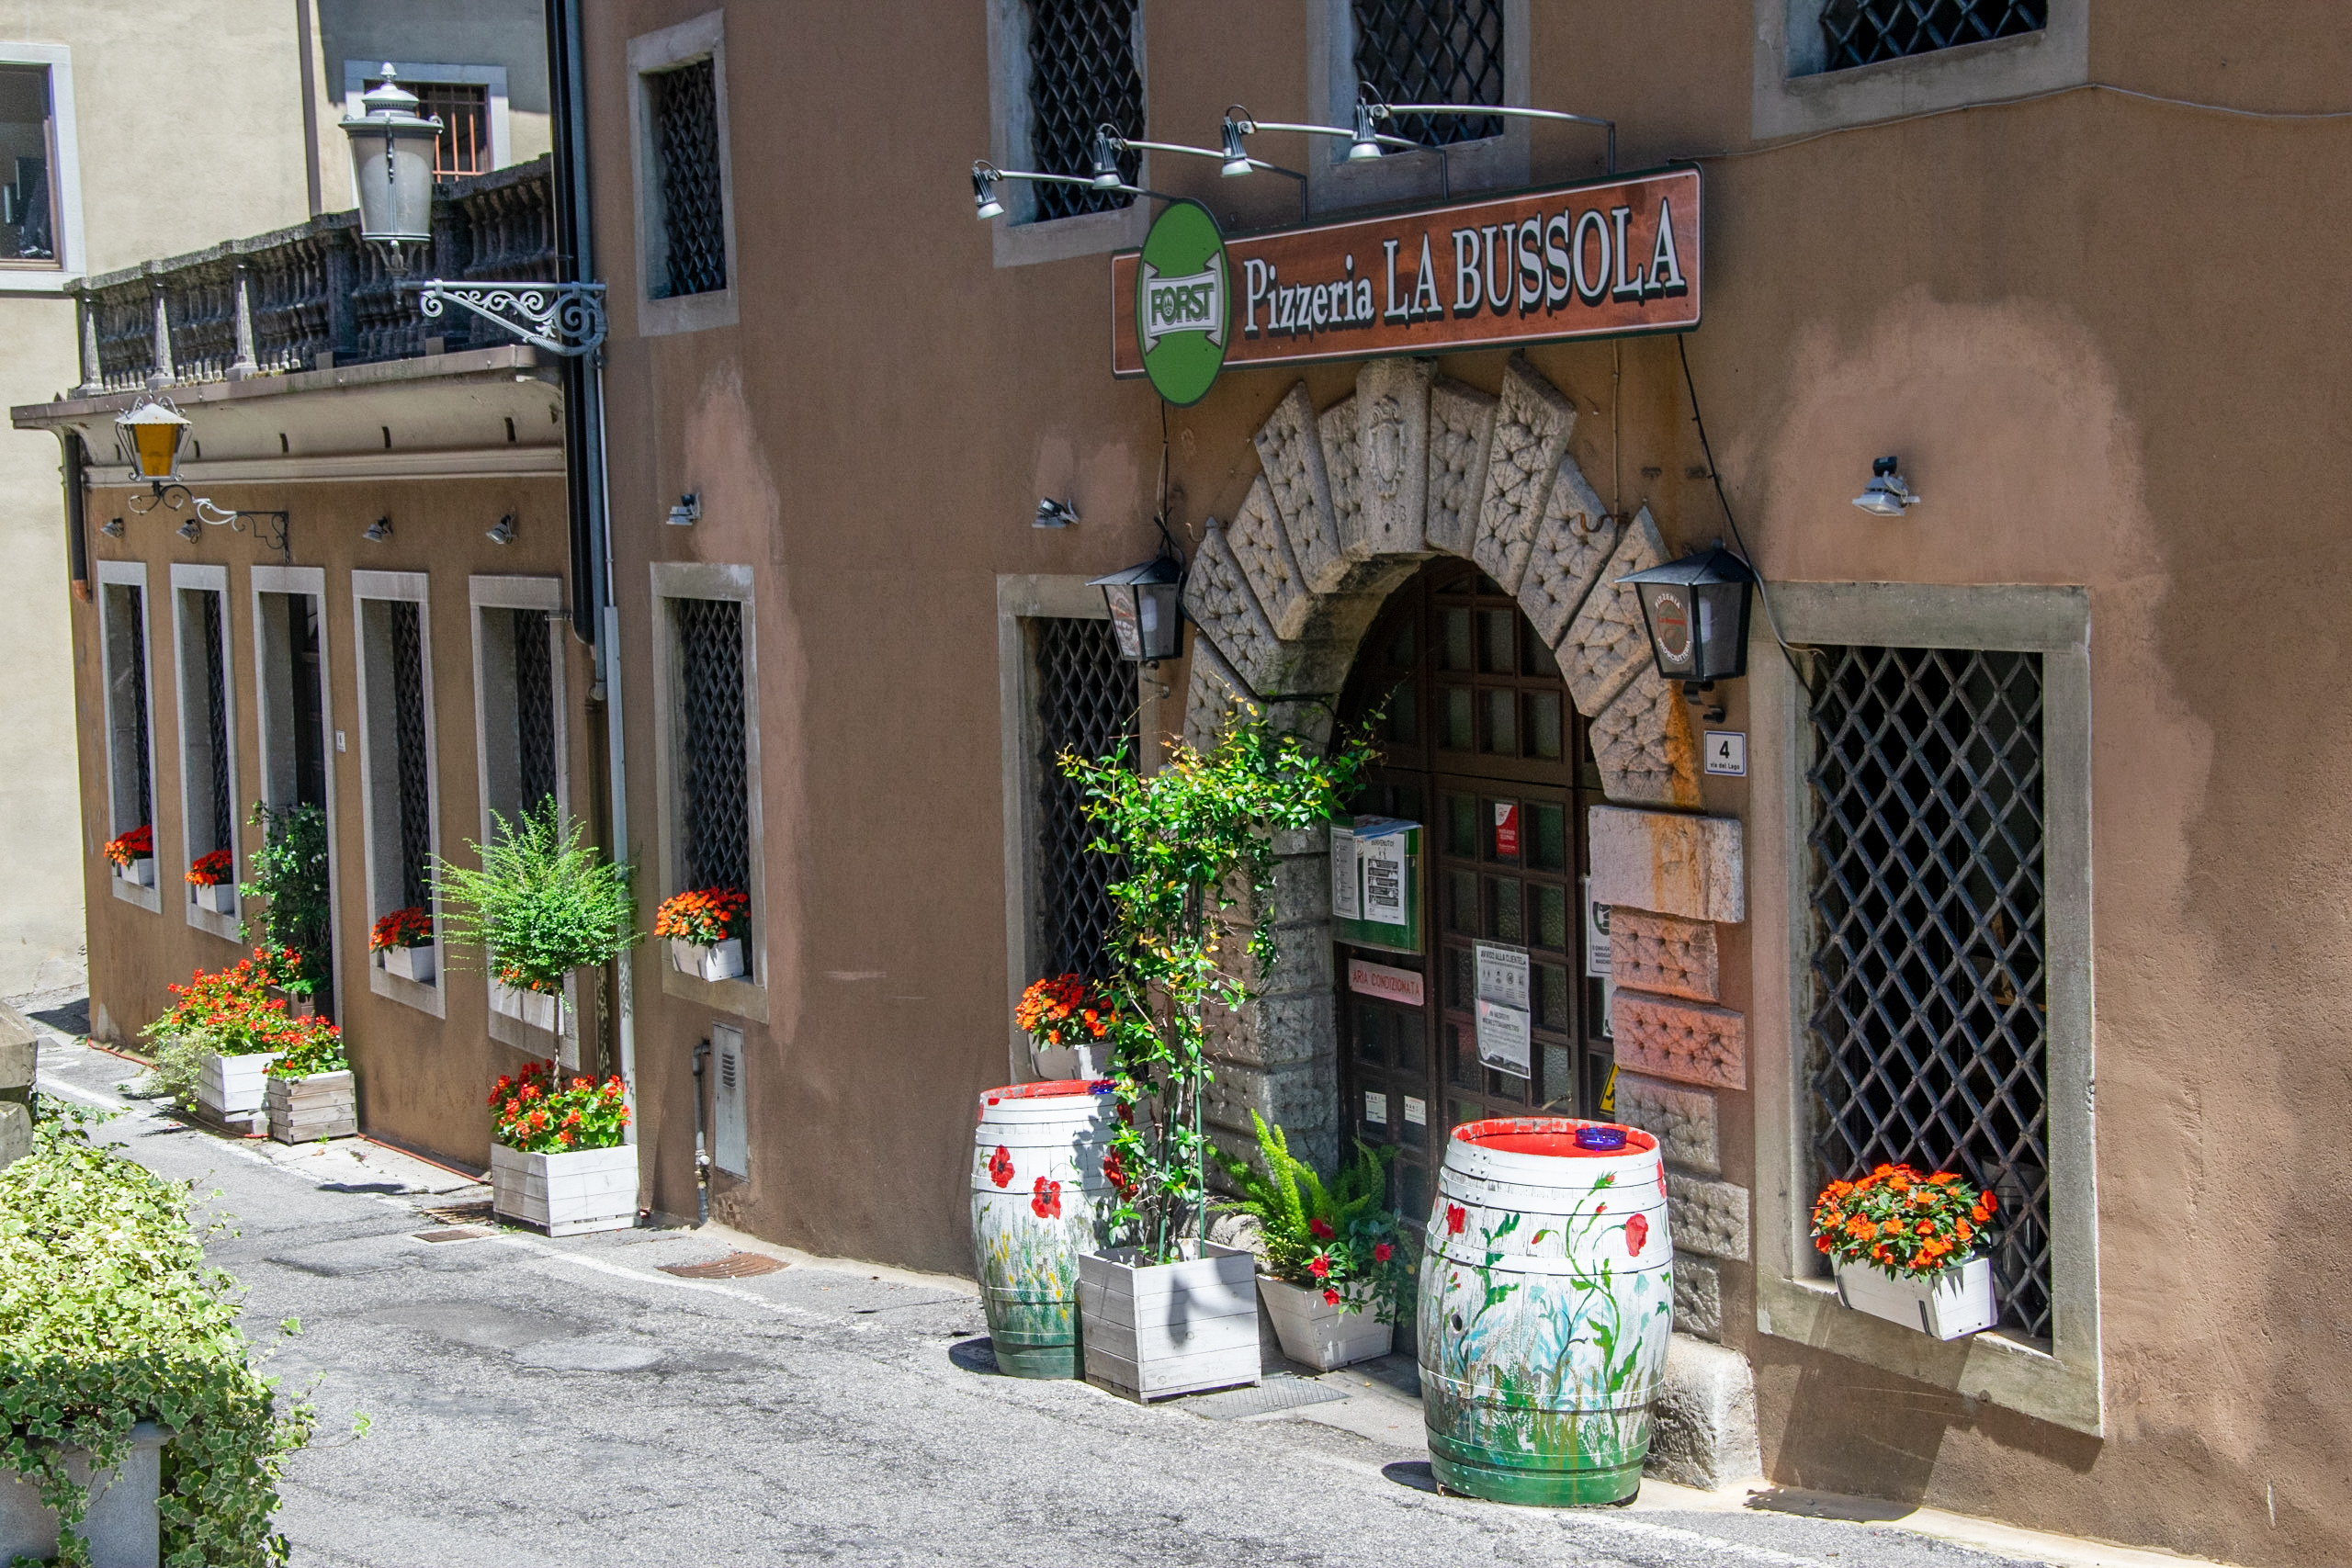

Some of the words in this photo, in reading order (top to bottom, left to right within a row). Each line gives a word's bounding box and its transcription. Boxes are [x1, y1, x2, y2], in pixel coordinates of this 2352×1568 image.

[1243, 254, 1375, 334] Pizzeria
[1383, 232, 1443, 321] LA
[1452, 197, 1687, 311] BUSSOLA
[1150, 281, 1215, 326] FORST
[1654, 592, 1680, 610] PIZZERIA
[1719, 740, 1730, 759] 4
[1352, 969, 1368, 984] ARIA
[1371, 973, 1420, 996] CONDIZIONATA
